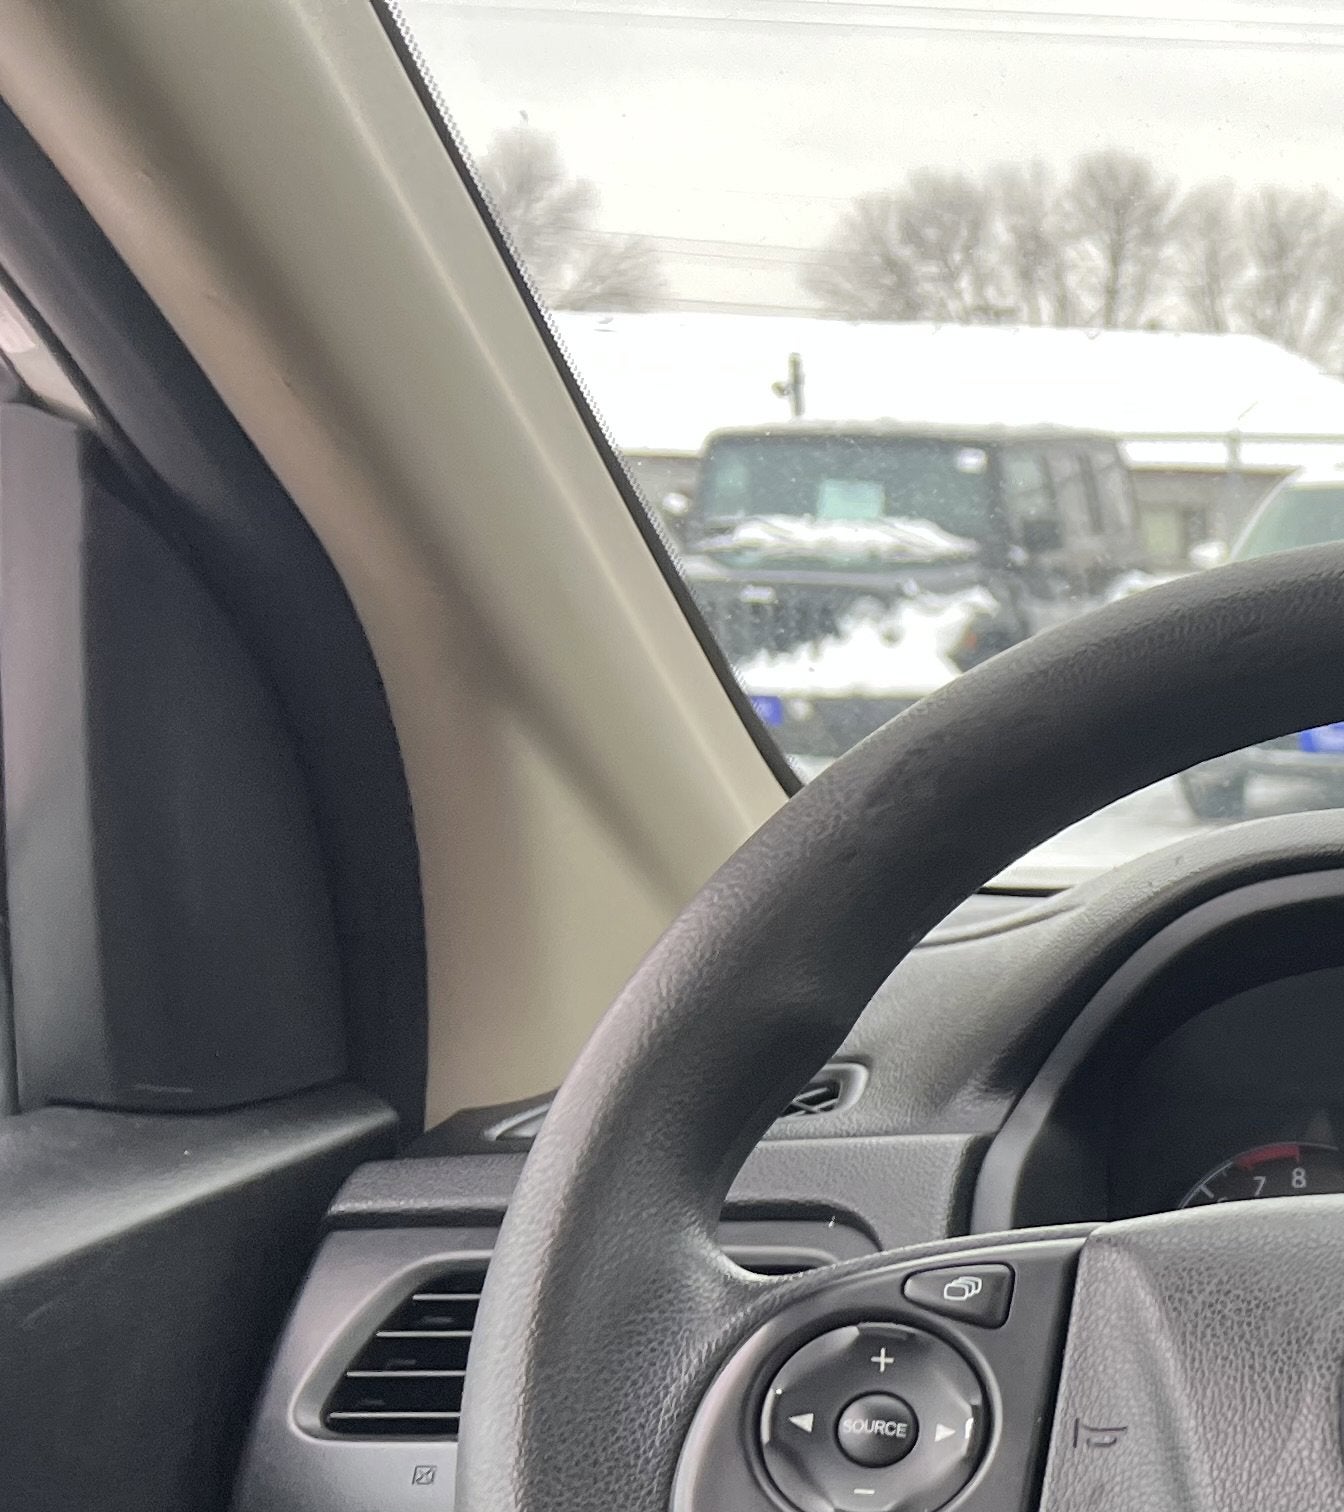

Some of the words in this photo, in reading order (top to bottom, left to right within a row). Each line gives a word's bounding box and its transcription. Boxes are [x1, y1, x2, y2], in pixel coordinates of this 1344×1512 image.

[1253, 1175, 1266, 1197] 7
[1291, 1167, 1306, 1189] 8
[842, 1418, 908, 1439] SOURCE
